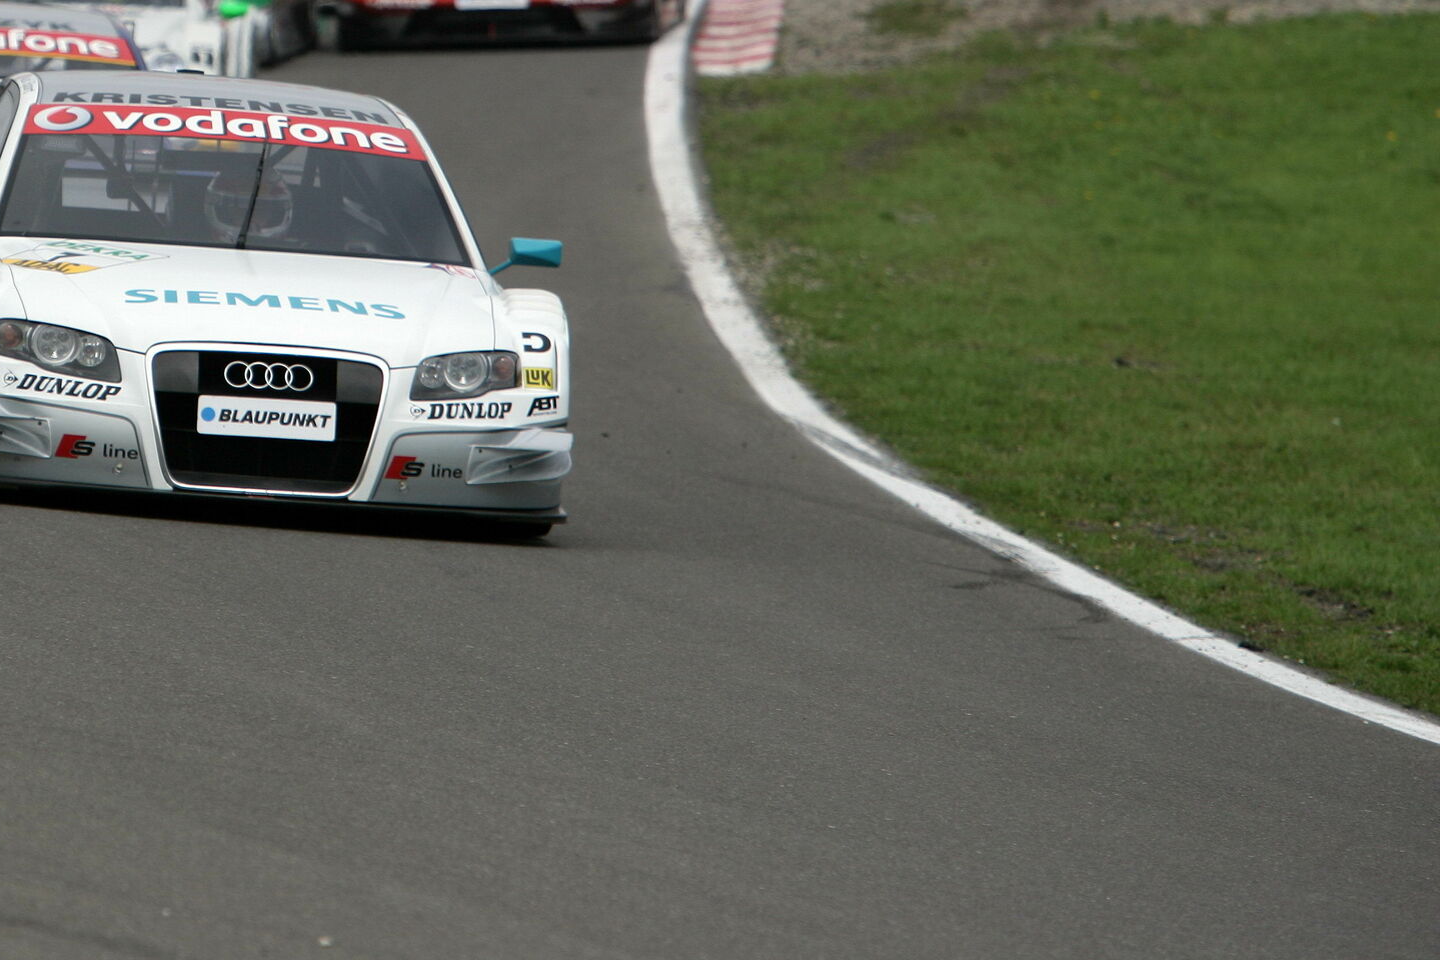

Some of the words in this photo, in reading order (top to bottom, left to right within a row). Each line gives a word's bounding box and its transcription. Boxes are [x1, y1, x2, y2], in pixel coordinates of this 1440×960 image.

[53, 91, 393, 125] KRISTENSEN
[102, 109, 410, 154] vodafone
[46, 241, 150, 260] DEKRA
[124, 289, 406, 320] SIEMENS
[16, 373, 122, 401] DUNLOP
[427, 401, 512, 420] DUNLOP
[527, 395, 559, 417] ABT
[219, 408, 331, 429] BLAUPUNKT
[103, 443, 138, 460] line
[431, 463, 463, 479] line
